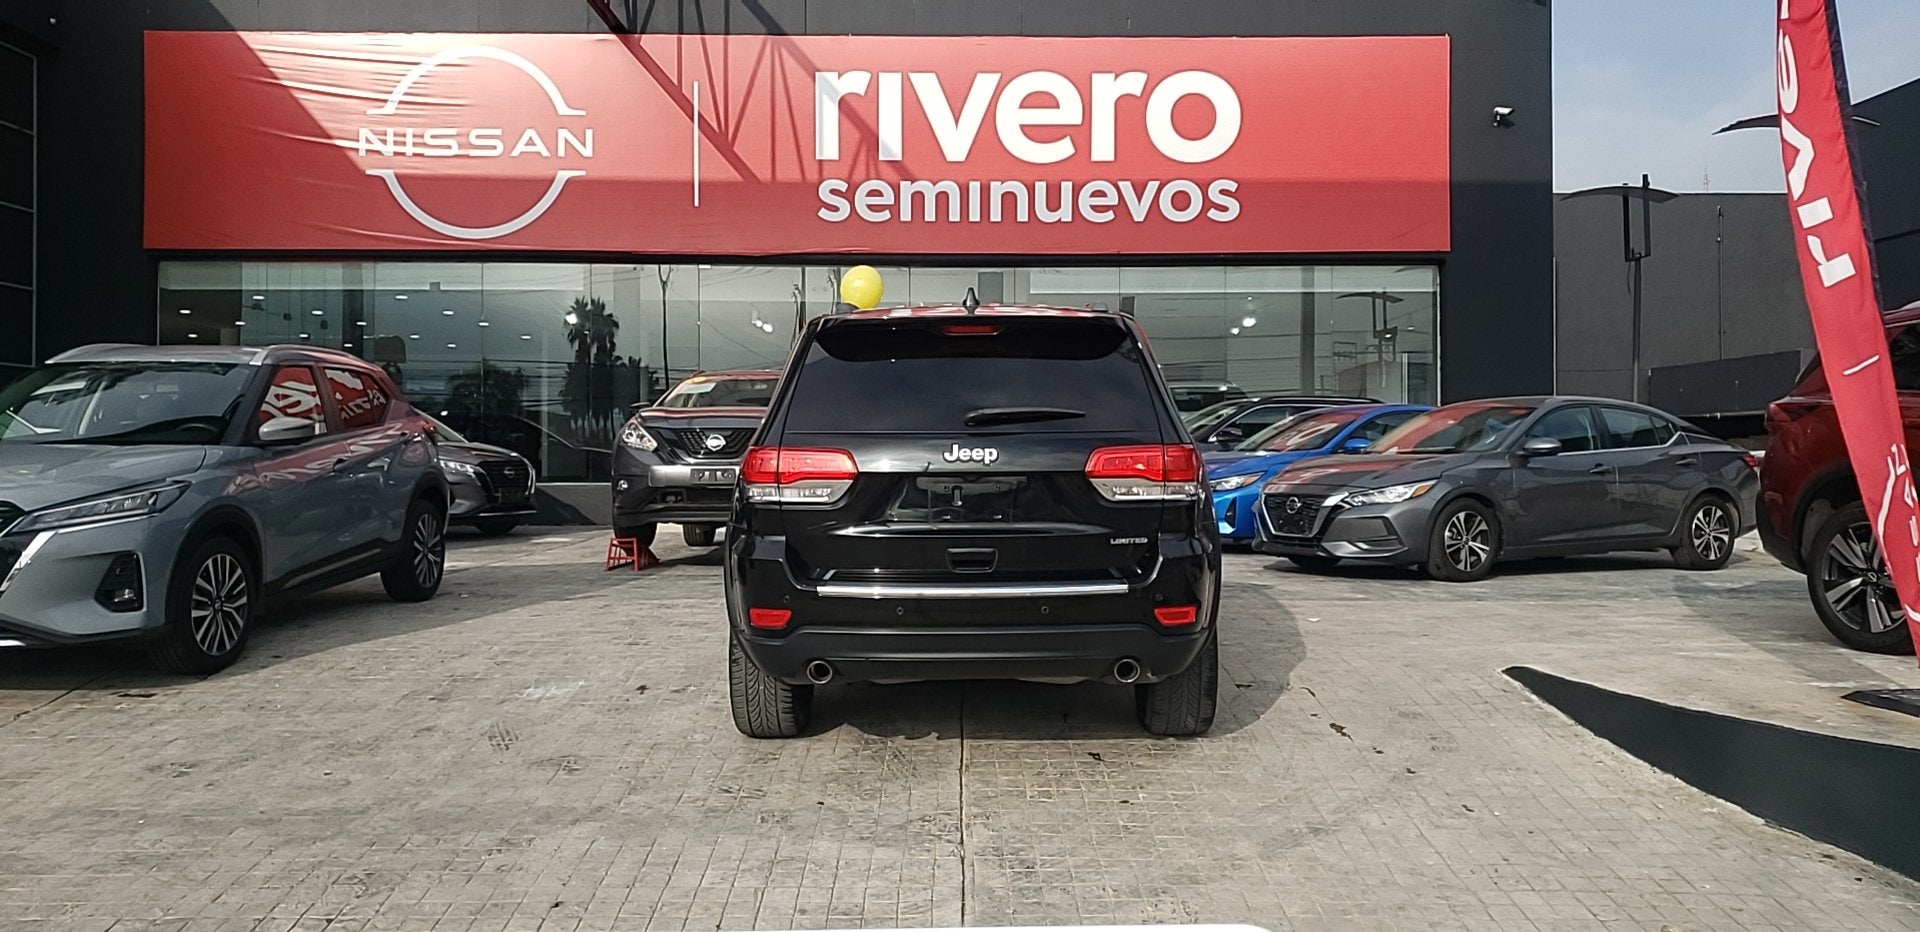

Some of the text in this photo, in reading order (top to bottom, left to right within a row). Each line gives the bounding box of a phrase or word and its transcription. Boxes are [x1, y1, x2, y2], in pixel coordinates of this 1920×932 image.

[815, 71, 1242, 163] rivero
[358, 128, 593, 158] NISSAN
[1777, 0, 1857, 288] rive
[817, 179, 1241, 223] seminuevos
[943, 443, 998, 466] Jeep
